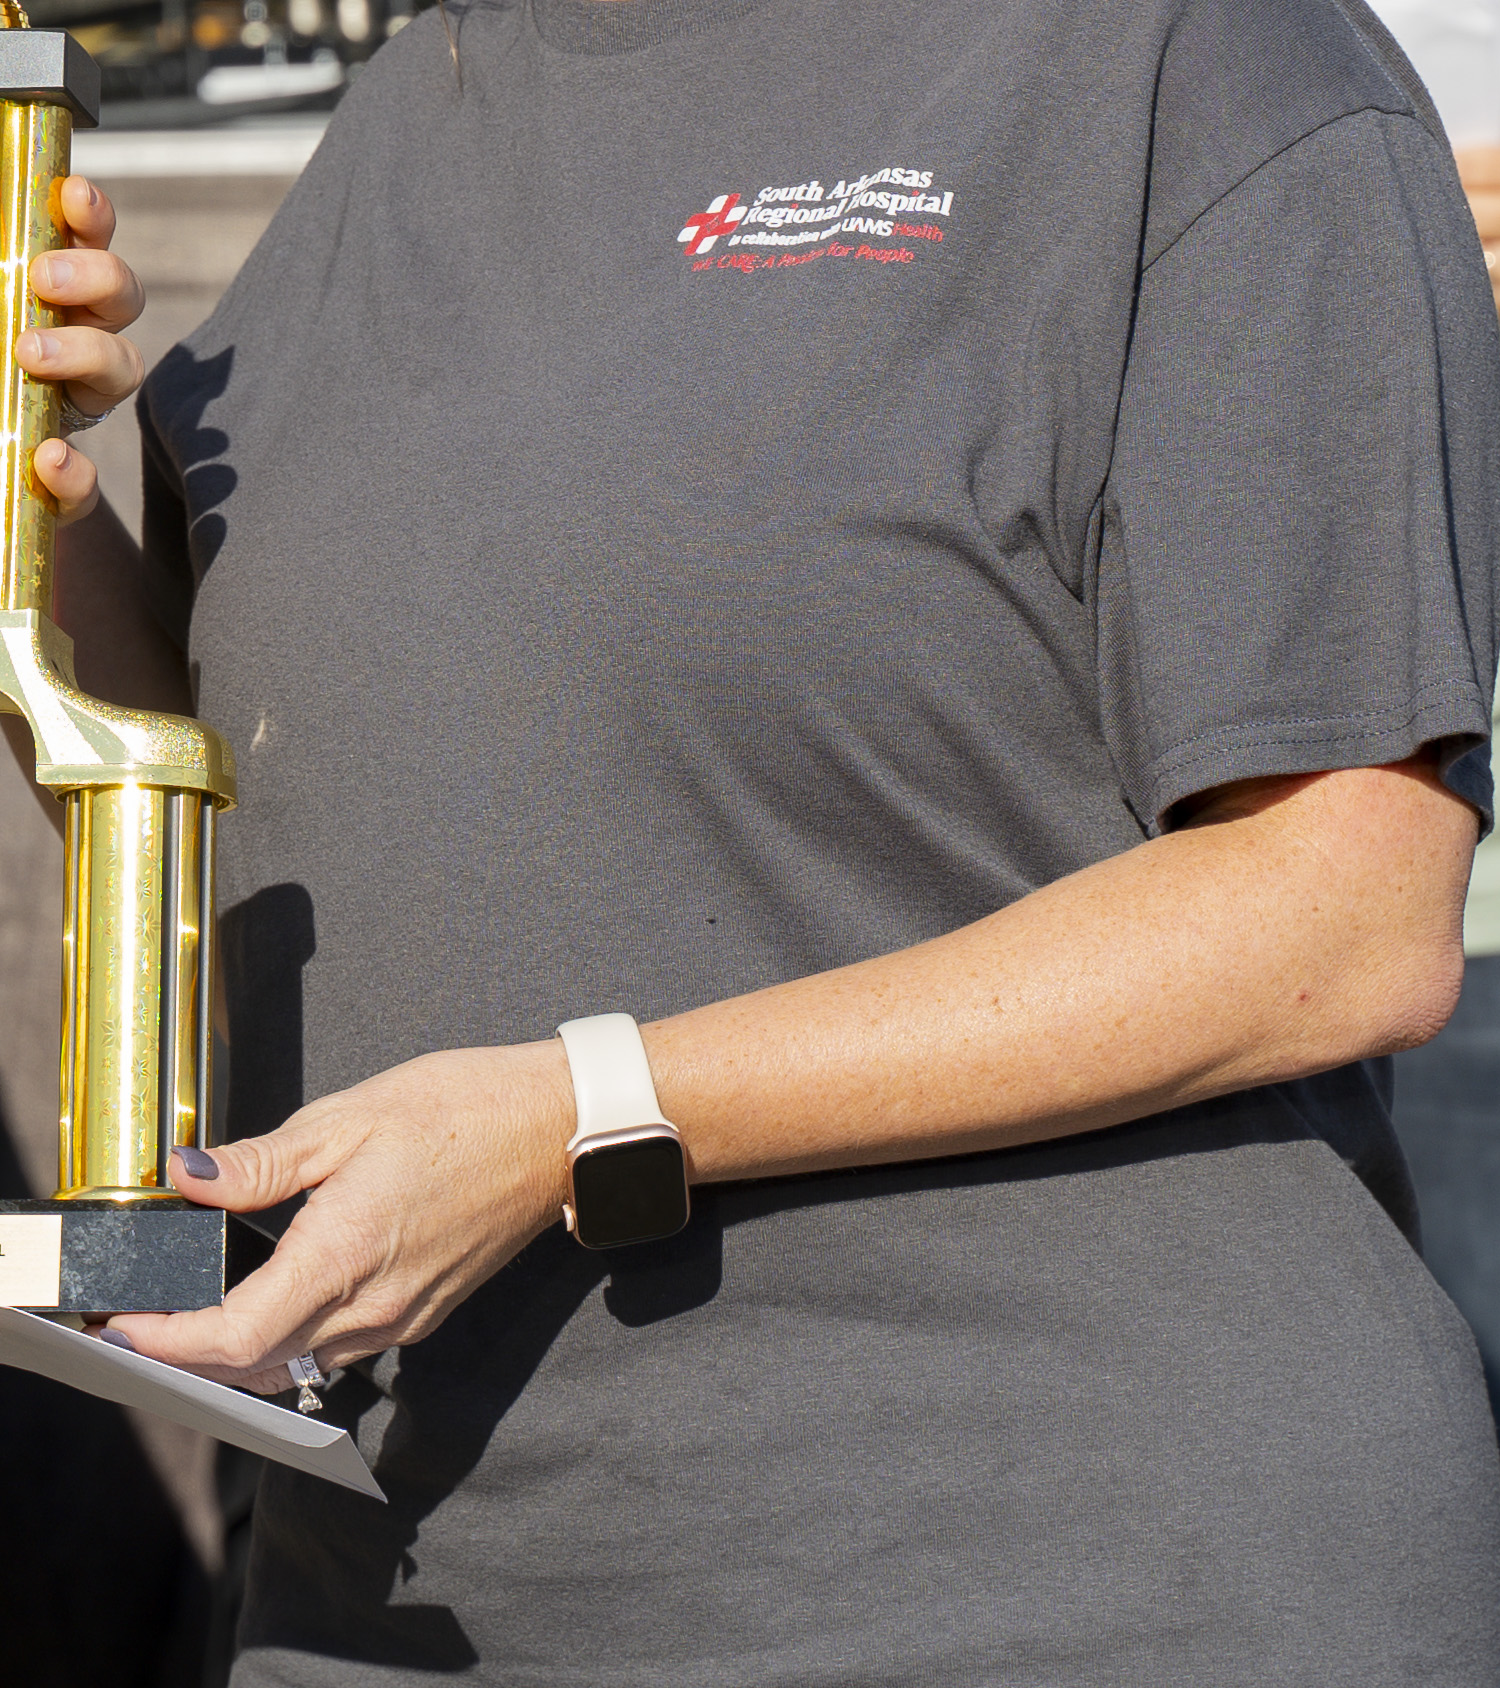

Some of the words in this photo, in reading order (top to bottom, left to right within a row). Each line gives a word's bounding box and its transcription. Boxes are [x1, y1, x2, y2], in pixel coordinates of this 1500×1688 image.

[753, 180, 824, 206] South
[826, 167, 934, 200] Arkansas
[741, 198, 849, 227] Regional
[844, 189, 954, 216] Hospital
